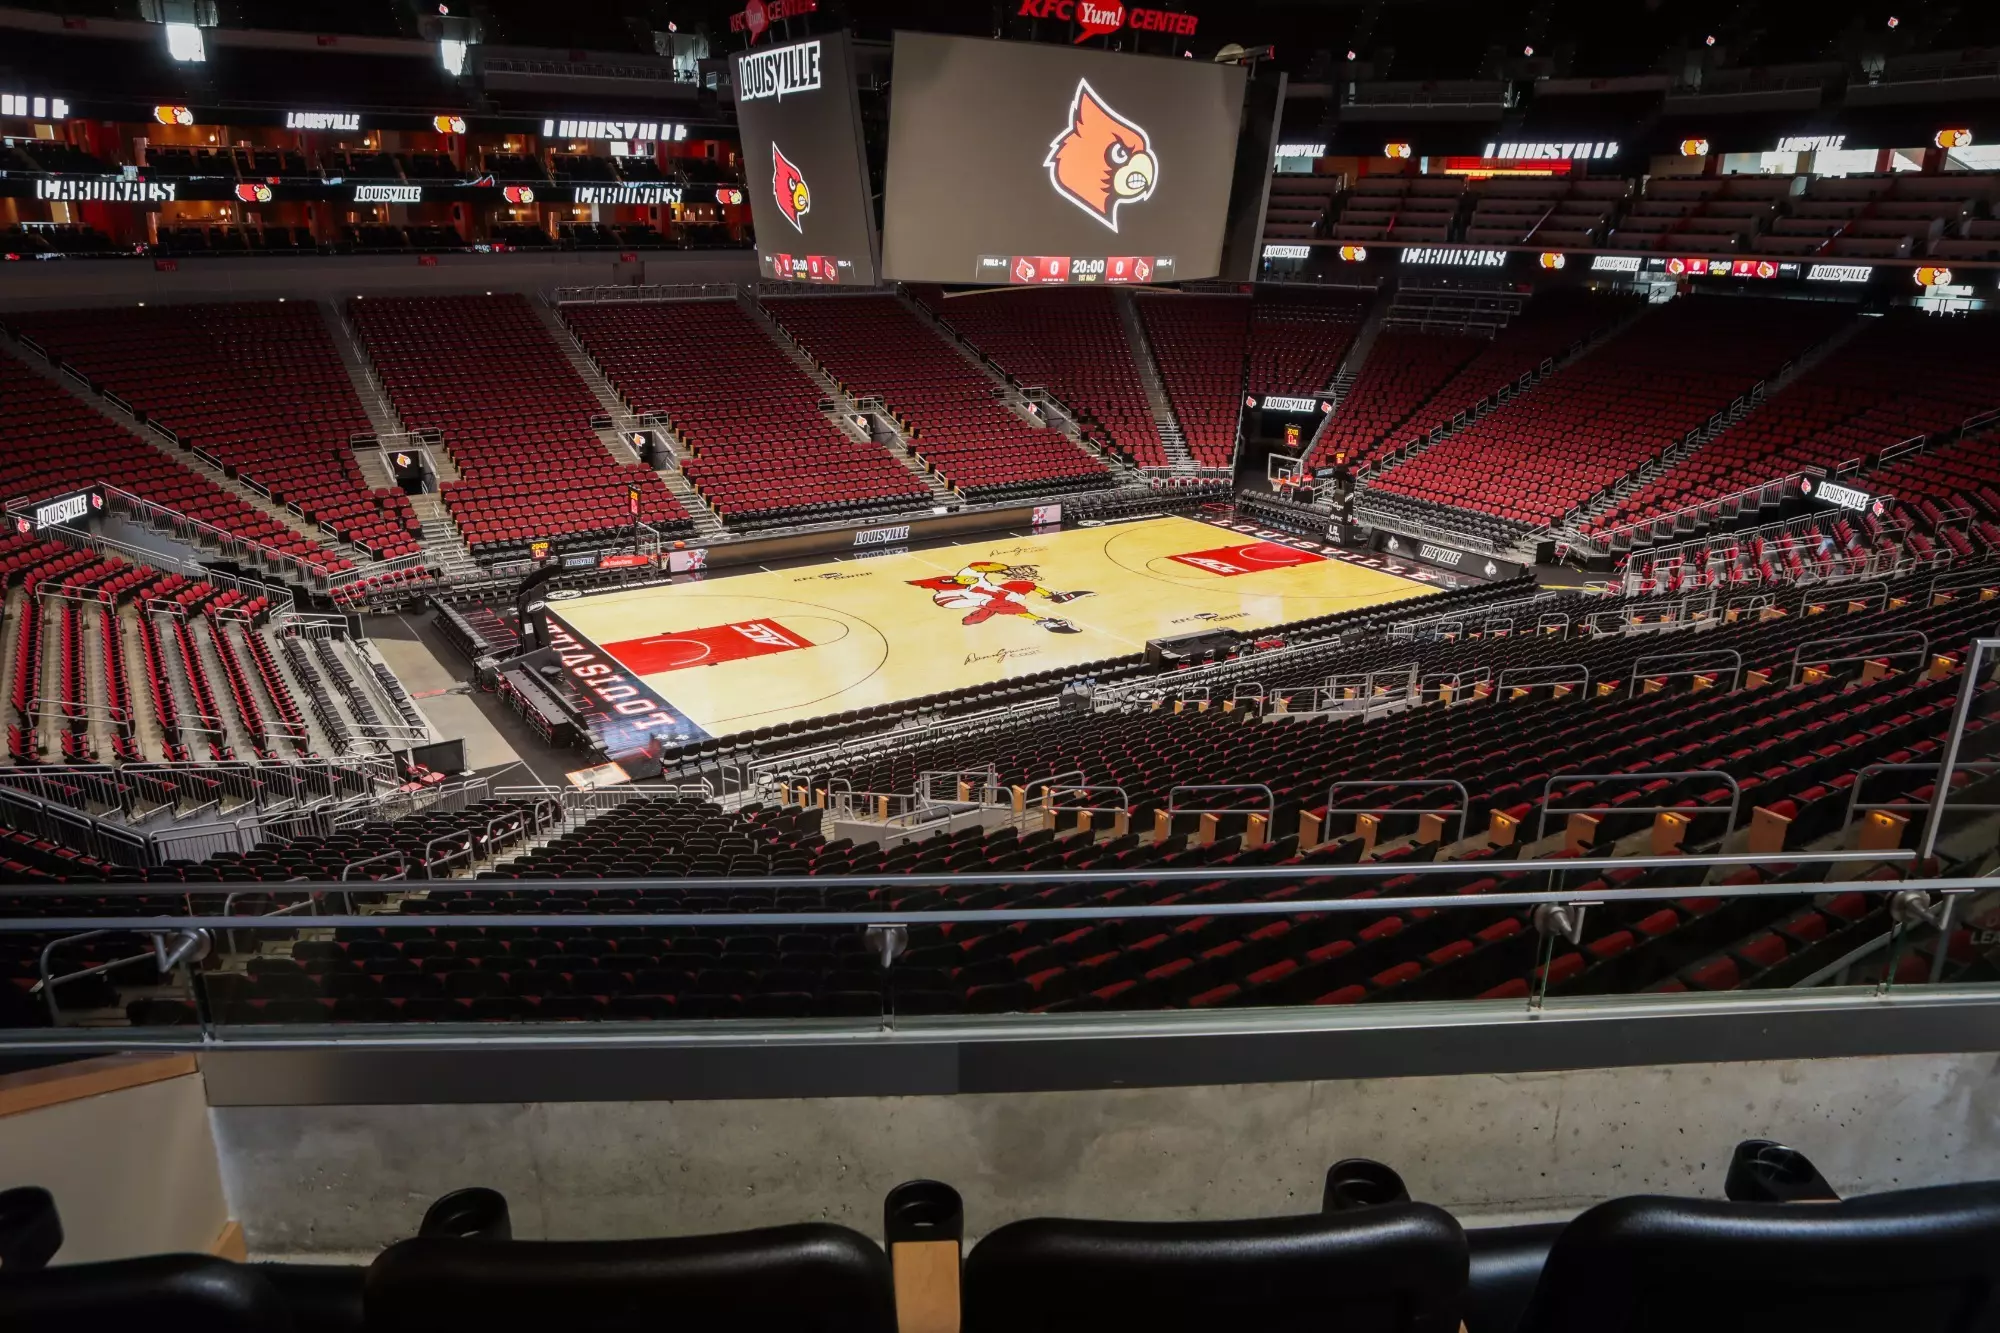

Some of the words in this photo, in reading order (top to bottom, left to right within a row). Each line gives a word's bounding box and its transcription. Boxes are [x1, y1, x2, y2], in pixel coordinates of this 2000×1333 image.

[1018, 0, 1073, 20] KFC
[1082, 3, 1122, 26] Yum!
[1130, 8, 1198, 36] CENTER
[739, 41, 820, 102] LOUISVILLE
[287, 112, 360, 131] LOUISVILLE
[1775, 135, 1845, 152] LOUISVILLE
[355, 186, 422, 202] LOUISVILLE
[1263, 245, 1310, 259] LOUISVILLE
[812, 260, 818, 273] 0
[1050, 260, 1059, 274] 0
[1071, 259, 1104, 274] 20:00
[1115, 260, 1124, 274] 0
[1592, 256, 1641, 271] LOUISVILLE
[1807, 264, 1872, 282] LOUISVILLE
[1262, 396, 1316, 412] LOUISVILLE
[1815, 481, 1870, 512] LOUISVILLE
[37, 494, 88, 530] LOUISVILLE
[854, 526, 909, 546] LOUISVILLE
[1326, 533, 1340, 543] Health
[1210, 519, 1438, 581] LOUISVILLE
[1420, 544, 1436, 559] THE
[1436, 548, 1462, 565] VILLE
[730, 623, 800, 647] ACC
